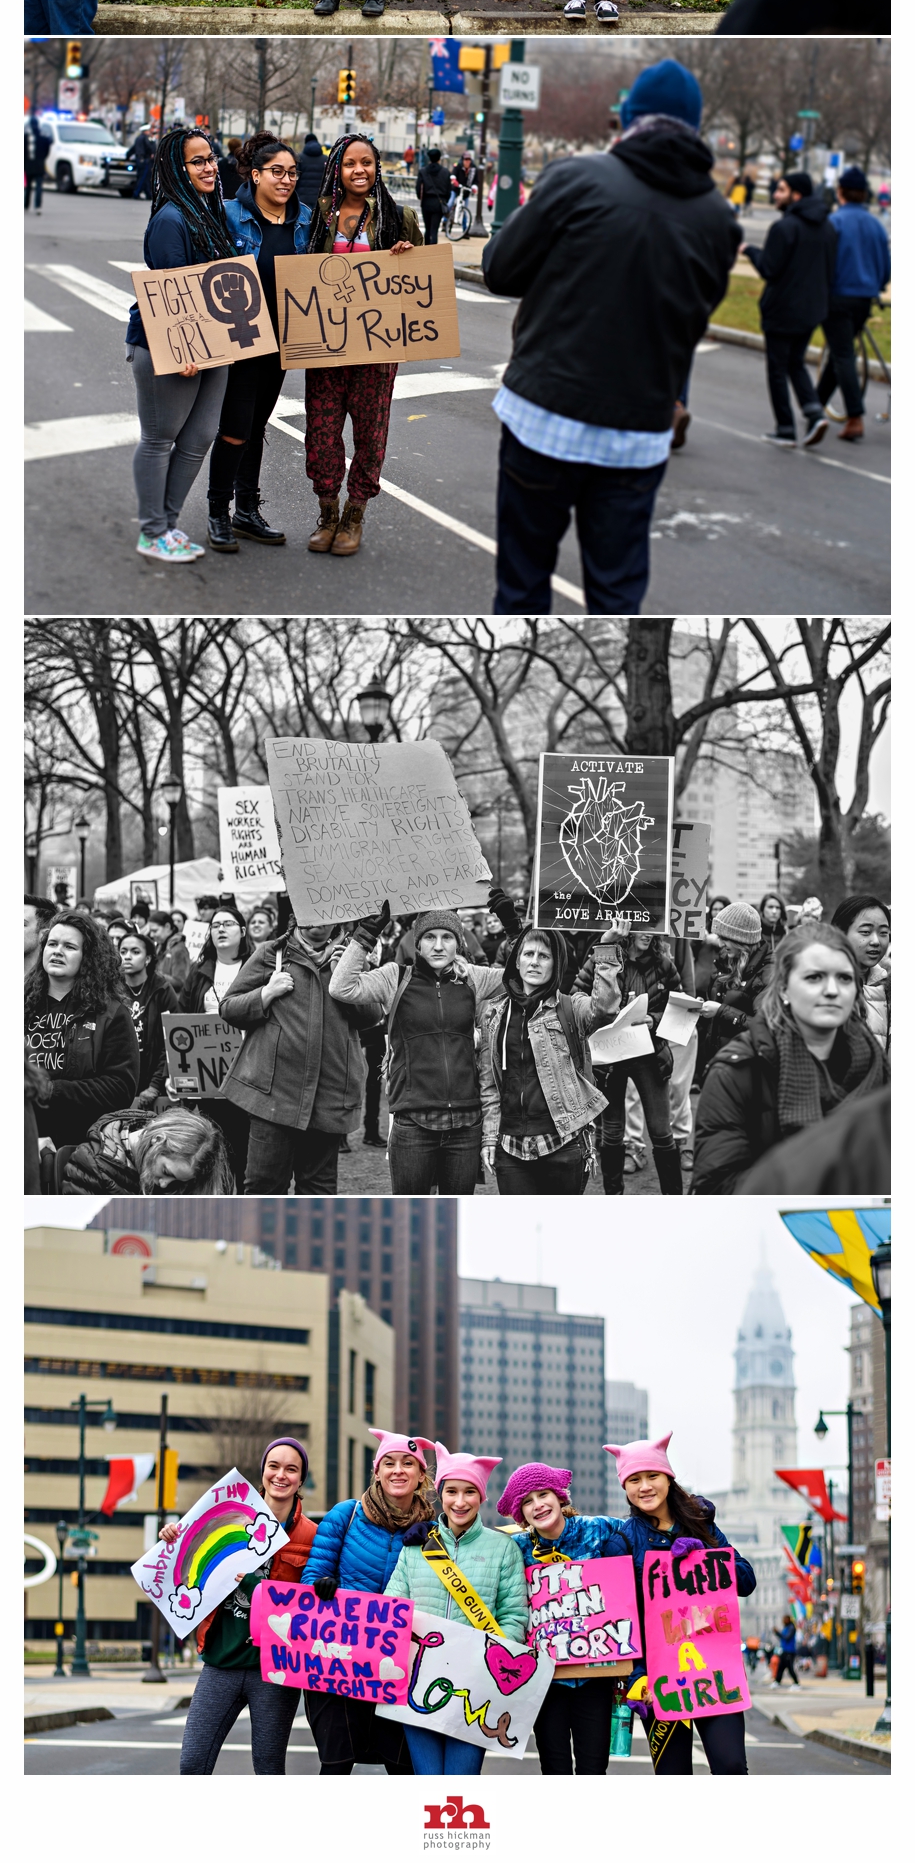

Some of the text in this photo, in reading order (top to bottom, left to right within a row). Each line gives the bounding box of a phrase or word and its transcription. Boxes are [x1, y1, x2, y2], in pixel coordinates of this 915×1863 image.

[511, 70, 530, 85] NO
[503, 88, 535, 102] TURNS
[143, 273, 205, 317] FIGHT
[282, 261, 433, 352] My Pussy
[175, 314, 196, 326] LIKE
[356, 309, 439, 351] Rules
[167, 322, 225, 364] GIRL
[273, 740, 382, 759] END POLICE
[296, 757, 380, 774] BRUTALITY
[571, 760, 644, 774] ACTIVATE
[283, 772, 378, 787] STAND FOR
[278, 785, 428, 805] TRANS HEALTHCARE
[235, 800, 259, 815] SEX
[289, 795, 457, 824] NATIVE SOVEREIGNTY
[226, 817, 265, 828] WORKER
[291, 810, 465, 843] DISABILITY RIGHTS
[231, 829, 262, 841] RIGHTS
[238, 841, 252, 849] ARE
[296, 828, 473, 863] IMMIGRANT RIGHTS
[231, 847, 267, 864] HUMAN
[304, 844, 482, 884] SEX WORKER RIGHTS
[235, 860, 281, 880] RIGHTS
[307, 862, 490, 904] DOMESTIC AND FARM
[400, 889, 464, 911] RIGHTS
[554, 891, 572, 900] the
[555, 908, 650, 922] LOVE ARMIES
[191, 1024, 211, 1038] THE
[528, 1563, 584, 1597] STY
[442, 1566, 467, 1595] STOP
[464, 1596, 487, 1623] GUN
[268, 1585, 410, 1628] WOMEN'S
[291, 1614, 398, 1656] RIGHTS
[311, 1639, 352, 1660] ARE
[678, 1642, 706, 1672] A
[271, 1644, 373, 1678] HUMAN
[308, 1674, 397, 1704] RIGHTS
